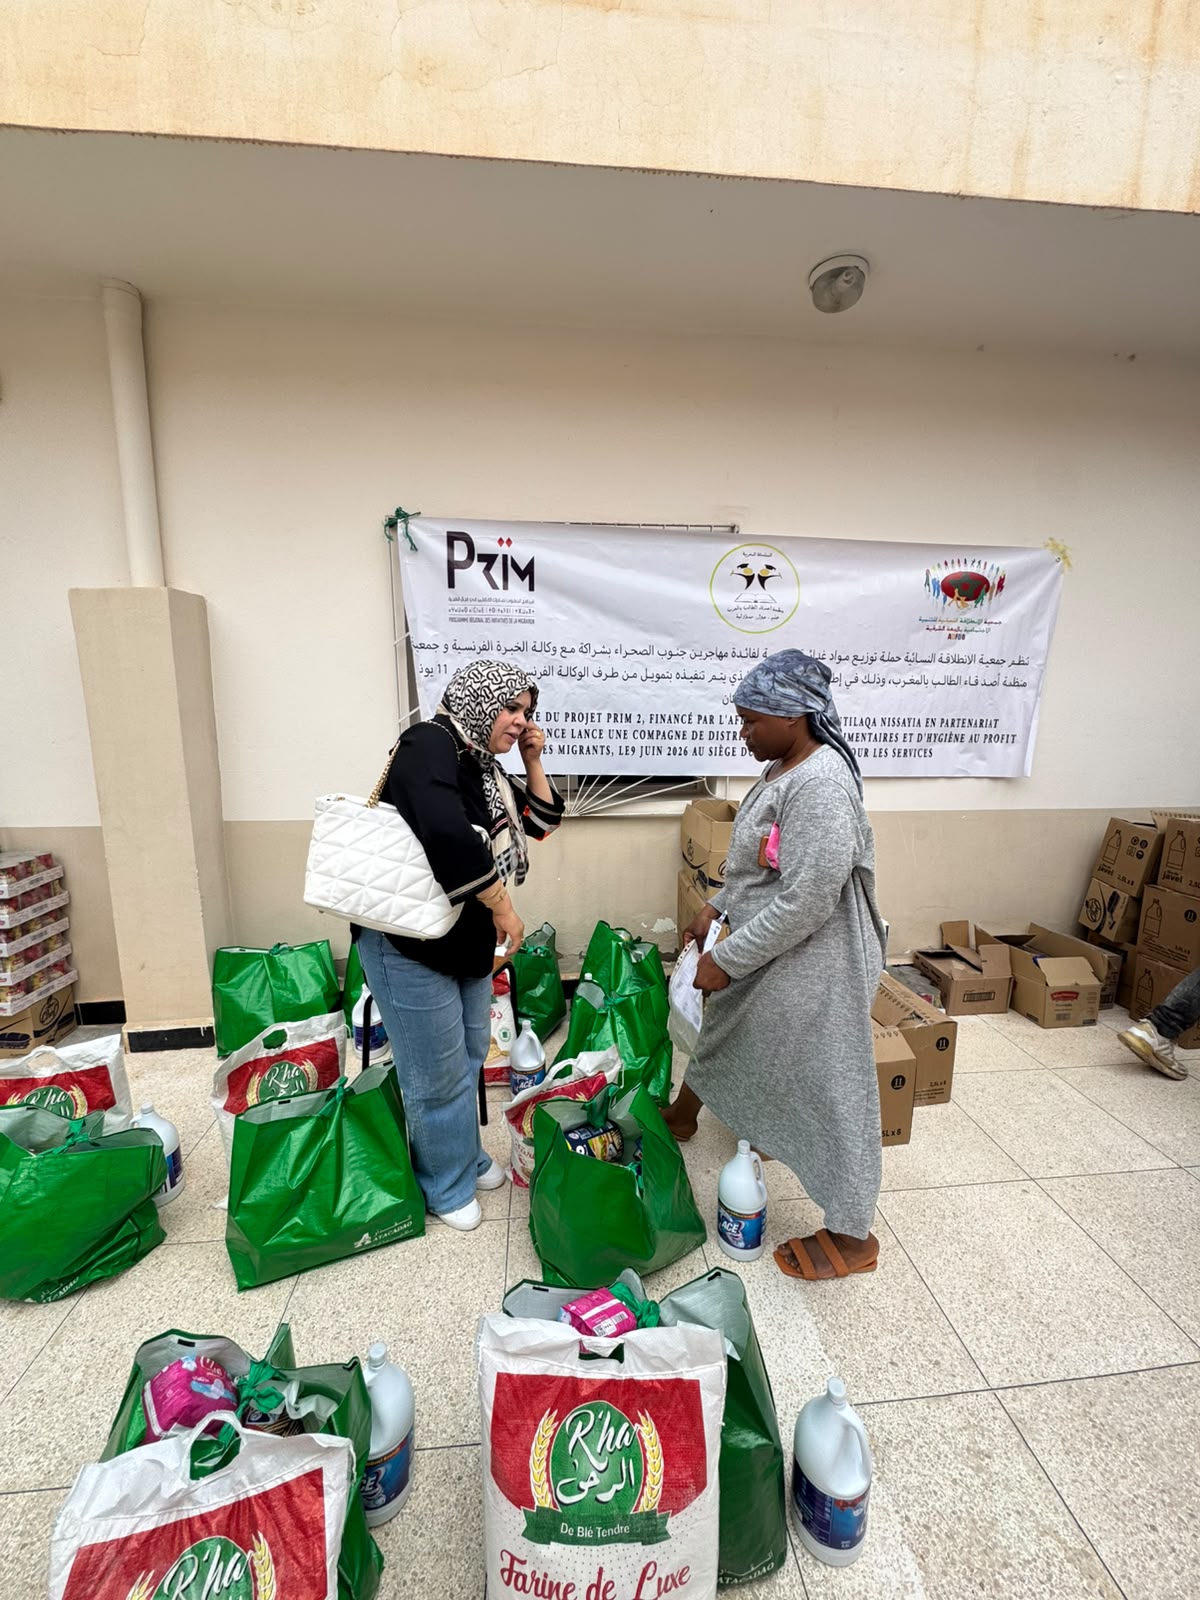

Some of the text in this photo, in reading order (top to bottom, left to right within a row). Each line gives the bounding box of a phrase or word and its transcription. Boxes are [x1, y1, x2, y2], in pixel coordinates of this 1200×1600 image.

[443, 643, 449, 654] و
[452, 639, 493, 654] الفرنسية
[496, 640, 528, 655] الخبرة
[531, 641, 557, 656] وكالة
[560, 645, 576, 658] مع
[578, 642, 611, 657] بشراكة
[614, 643, 654, 658] الصحراء
[657, 648, 687, 660] جنوب
[689, 645, 728, 661] مهاجرين
[731, 646, 760, 659] لفائدة
[829, 650, 849, 664] مواد
[852, 652, 877, 666] توزيع
[880, 651, 901, 663] حملة
[904, 651, 936, 666] النسائية
[938, 653, 976, 665] الانطلاقة
[980, 653, 1006, 668] جمعية
[438, 664, 448, 674] 11
[557, 666, 589, 682] الوكالة
[592, 667, 619, 681] طرف
[622, 671, 638, 682] من
[640, 668, 673, 683] بتمويل
[676, 671, 705, 684] تنفيذه
[708, 672, 727, 685] يتم
[845, 672, 859, 689] في
[861, 672, 886, 687] وذلك
[931, 675, 962, 689] الطالب
[545, 711, 560, 722] DU
[564, 711, 602, 725] PROJET
[606, 712, 632, 724] PRIM
[649, 711, 693, 725] FINANCÉ
[697, 714, 715, 725] PAR
[880, 717, 921, 728] NISSAYIA
[925, 717, 937, 728] EN
[939, 717, 999, 729] PARTENARIAT
[571, 728, 604, 739] LANCE
[608, 729, 629, 740] UNE
[632, 729, 688, 741] COMPAGNE
[691, 730, 704, 741] DE
[902, 732, 914, 743] ET
[916, 731, 966, 744] D'HYGIÈNE
[968, 733, 981, 744] AU
[983, 733, 1017, 744] PROFIT
[557, 744, 614, 757] MIGRANTS,
[639, 745, 663, 758] JUIN
[667, 746, 689, 757] 2026
[691, 746, 705, 757] AU
[708, 744, 737, 757] SIÈGE
[872, 747, 889, 758] LES
[892, 747, 933, 758] SERVICES
[721, 1221, 740, 1234] ACE
[566, 1409, 640, 1472] R'ha
[561, 1522, 630, 1538] De Blé Tendre
[500, 1549, 578, 1600] Farine
[586, 1566, 617, 1600] de
[632, 1560, 692, 1600] Luxe
